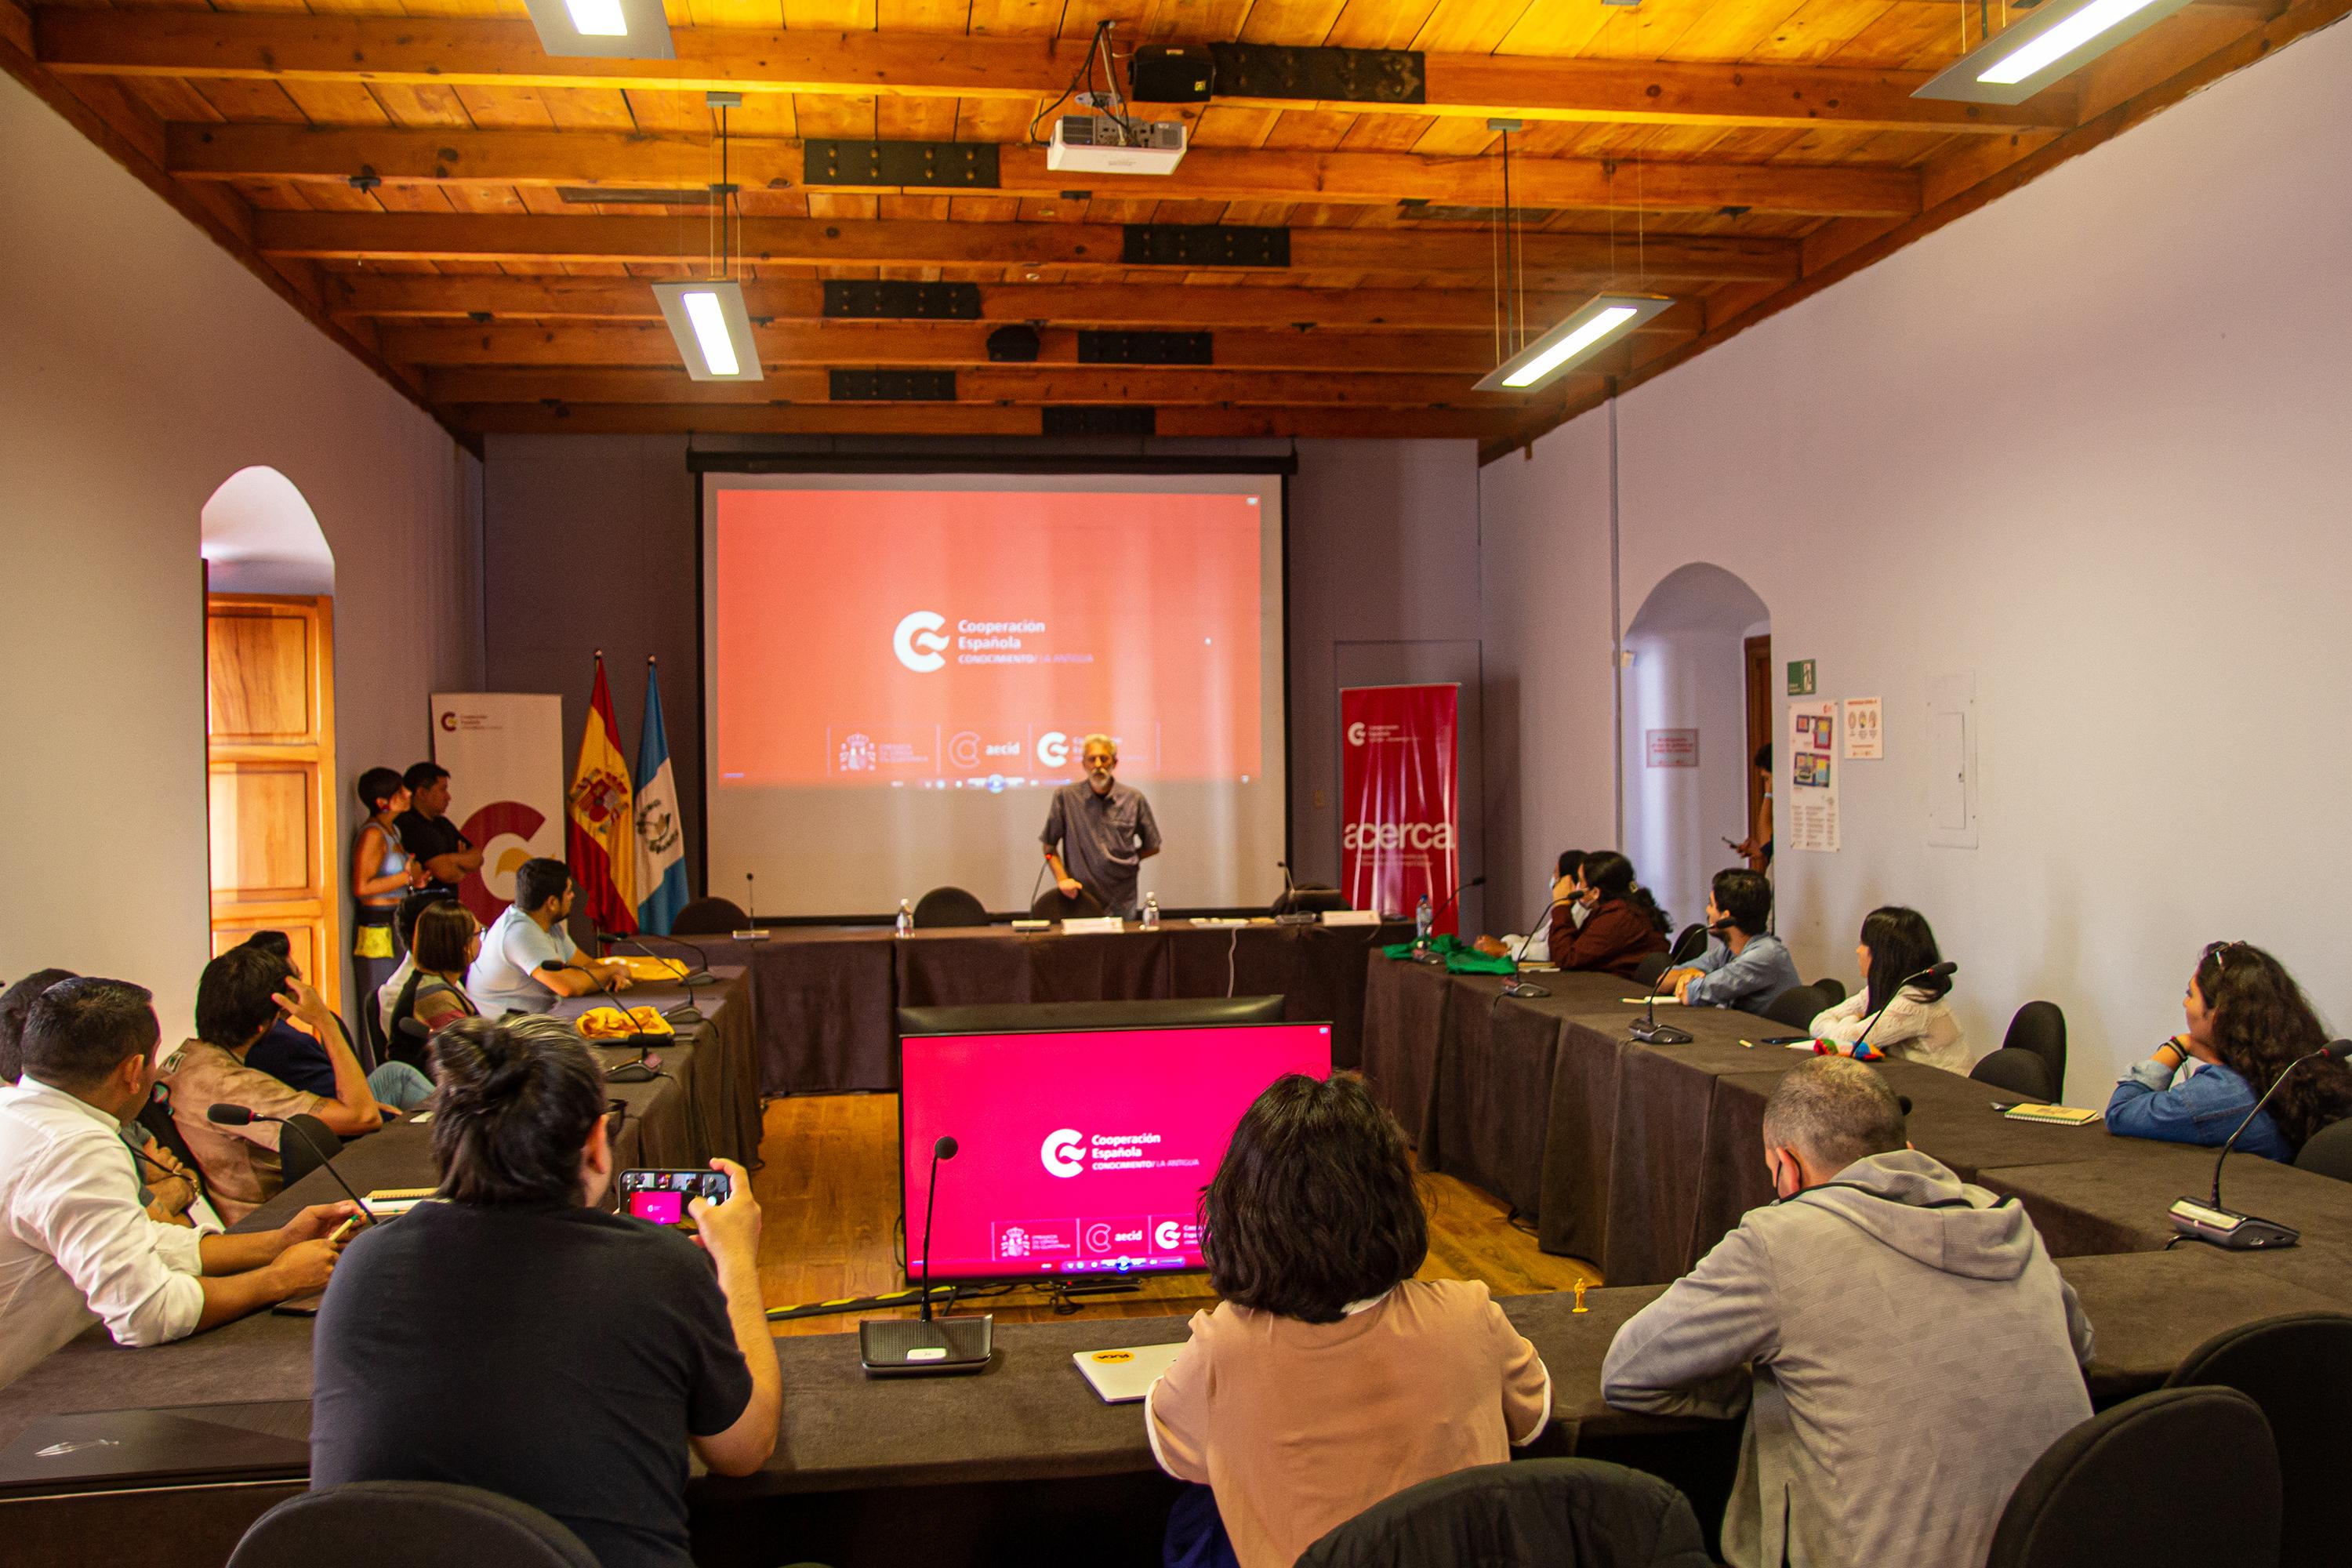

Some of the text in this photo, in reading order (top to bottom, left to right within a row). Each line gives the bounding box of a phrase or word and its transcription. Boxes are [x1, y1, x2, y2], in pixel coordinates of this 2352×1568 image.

[958, 619, 1046, 635] Cooperación
[958, 636, 1022, 652] Española
[985, 740, 1020, 756] aecid
[1344, 822, 1456, 850] acerca
[1091, 1133, 1161, 1147] Cooperación
[1091, 1146, 1142, 1160] Española
[1114, 1230, 1142, 1241] aecid
